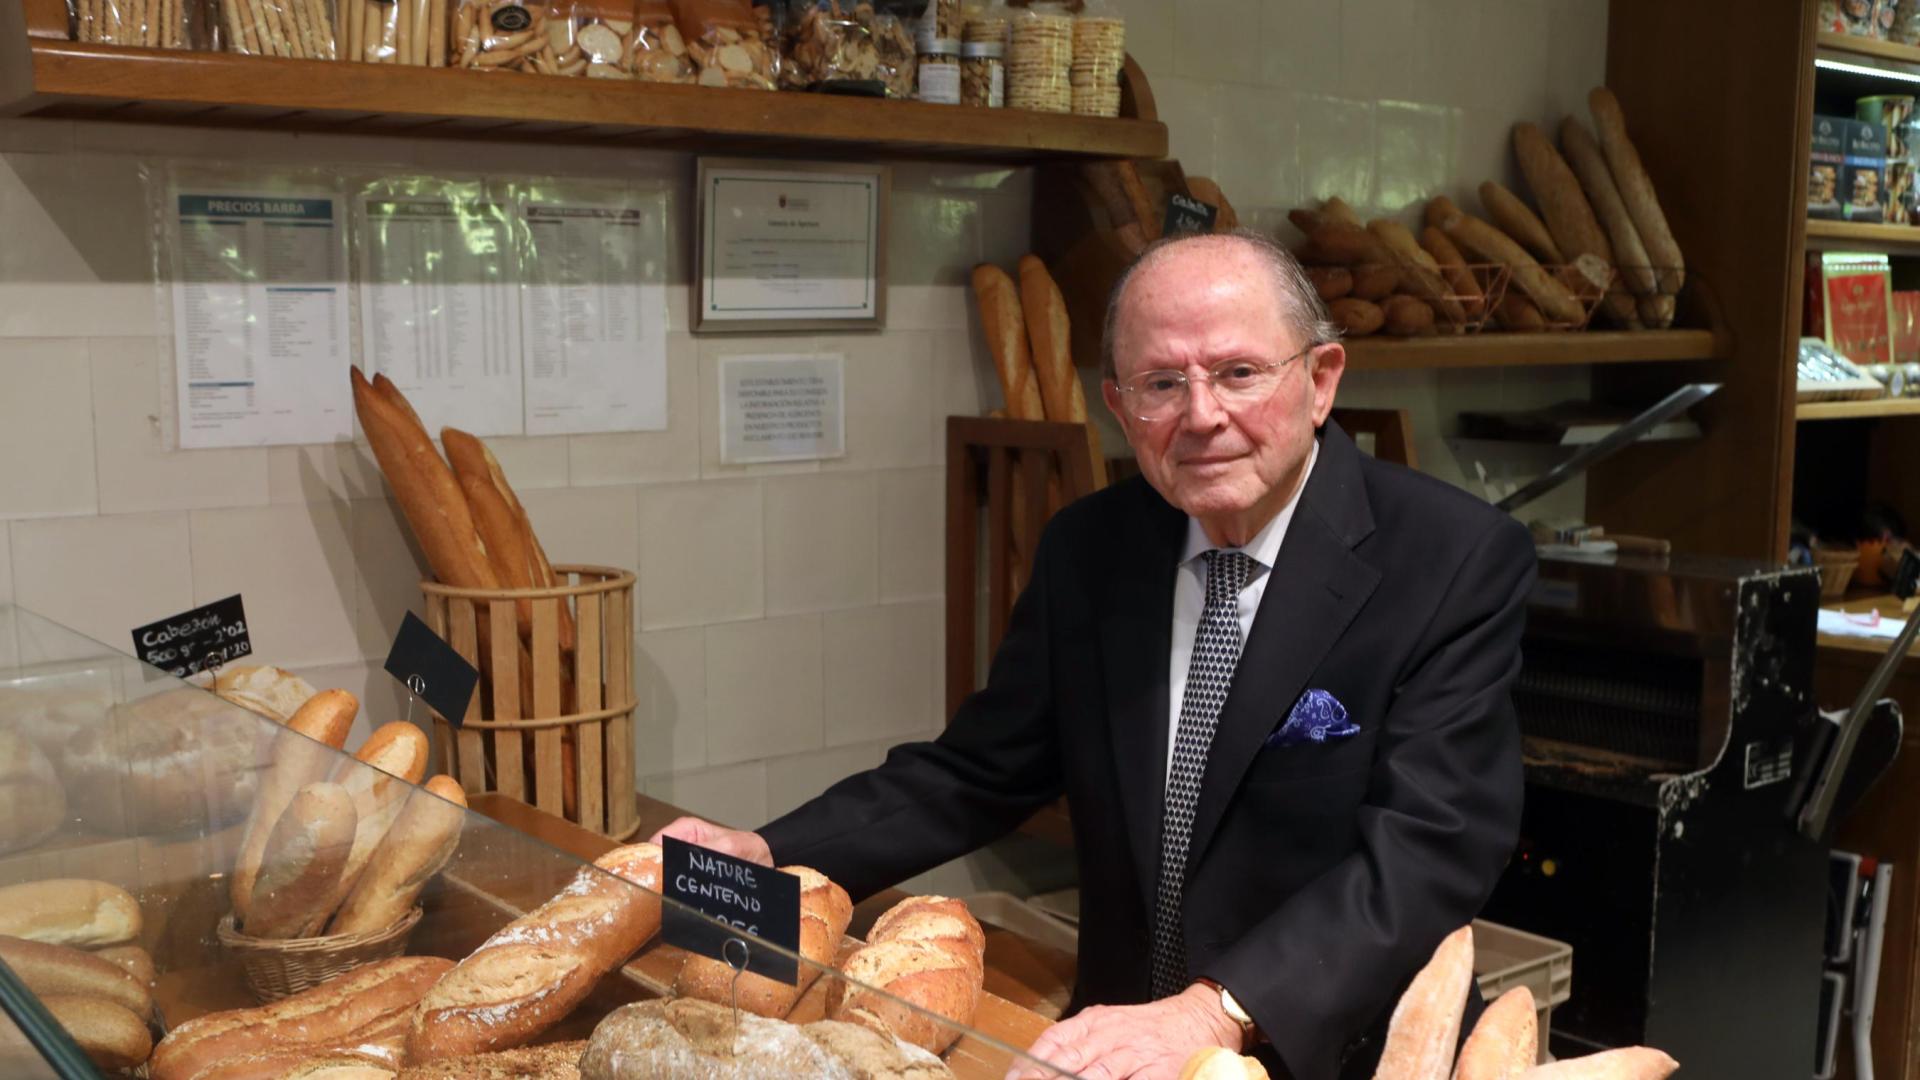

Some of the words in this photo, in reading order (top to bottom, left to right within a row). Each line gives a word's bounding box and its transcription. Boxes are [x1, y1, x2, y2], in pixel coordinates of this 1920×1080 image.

[208, 200, 261, 214] PRECIOS
[264, 202, 305, 215] BARRA
[689, 852, 758, 889] NATURE
[675, 874, 761, 912] CENTENO
